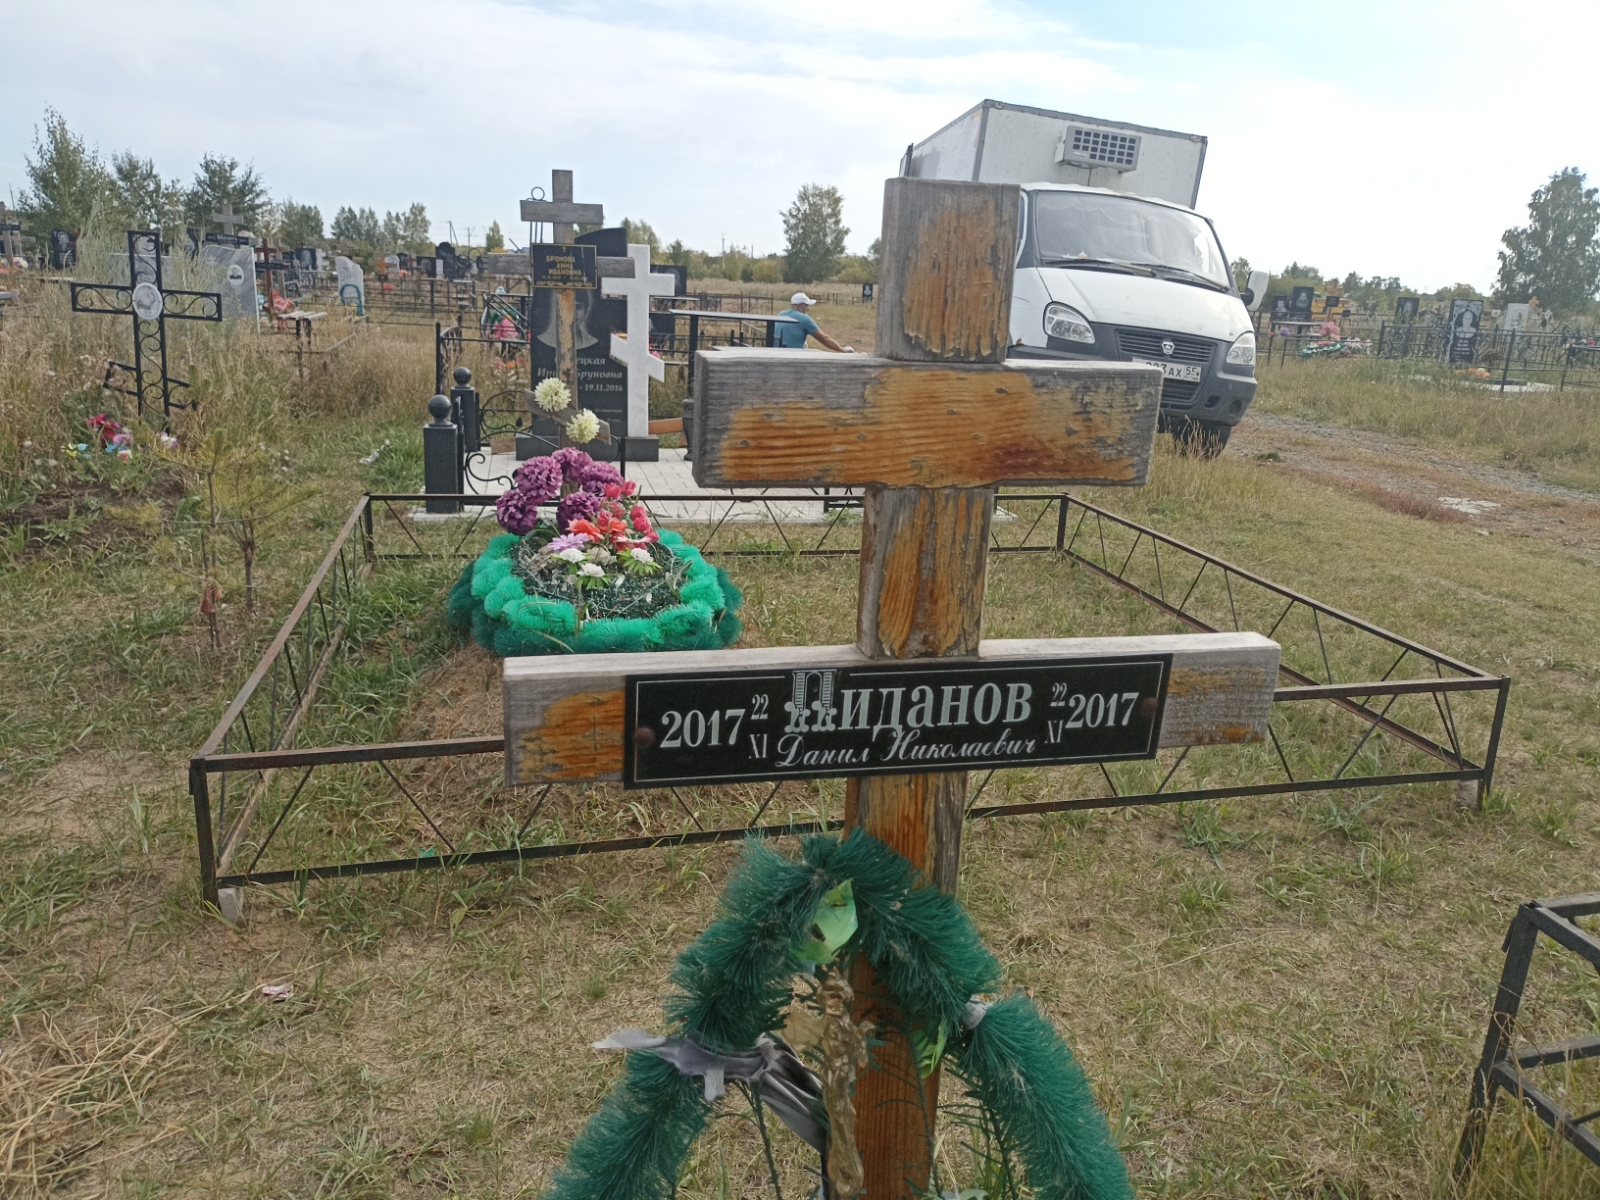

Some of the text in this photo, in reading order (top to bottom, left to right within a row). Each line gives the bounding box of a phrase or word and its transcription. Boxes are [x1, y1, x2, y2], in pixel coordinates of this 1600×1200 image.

[548, 268, 582, 276] ИВАНОВНА
[556, 262, 574, 270] АННА
[585, 384, 624, 392] 19.11.2016
[659, 668, 1140, 749] 2017 22 Пиданов 22 2017
[1044, 719, 1064, 744] XI
[748, 733, 768, 760] XI
[774, 727, 1036, 767] Данил Николаевич
